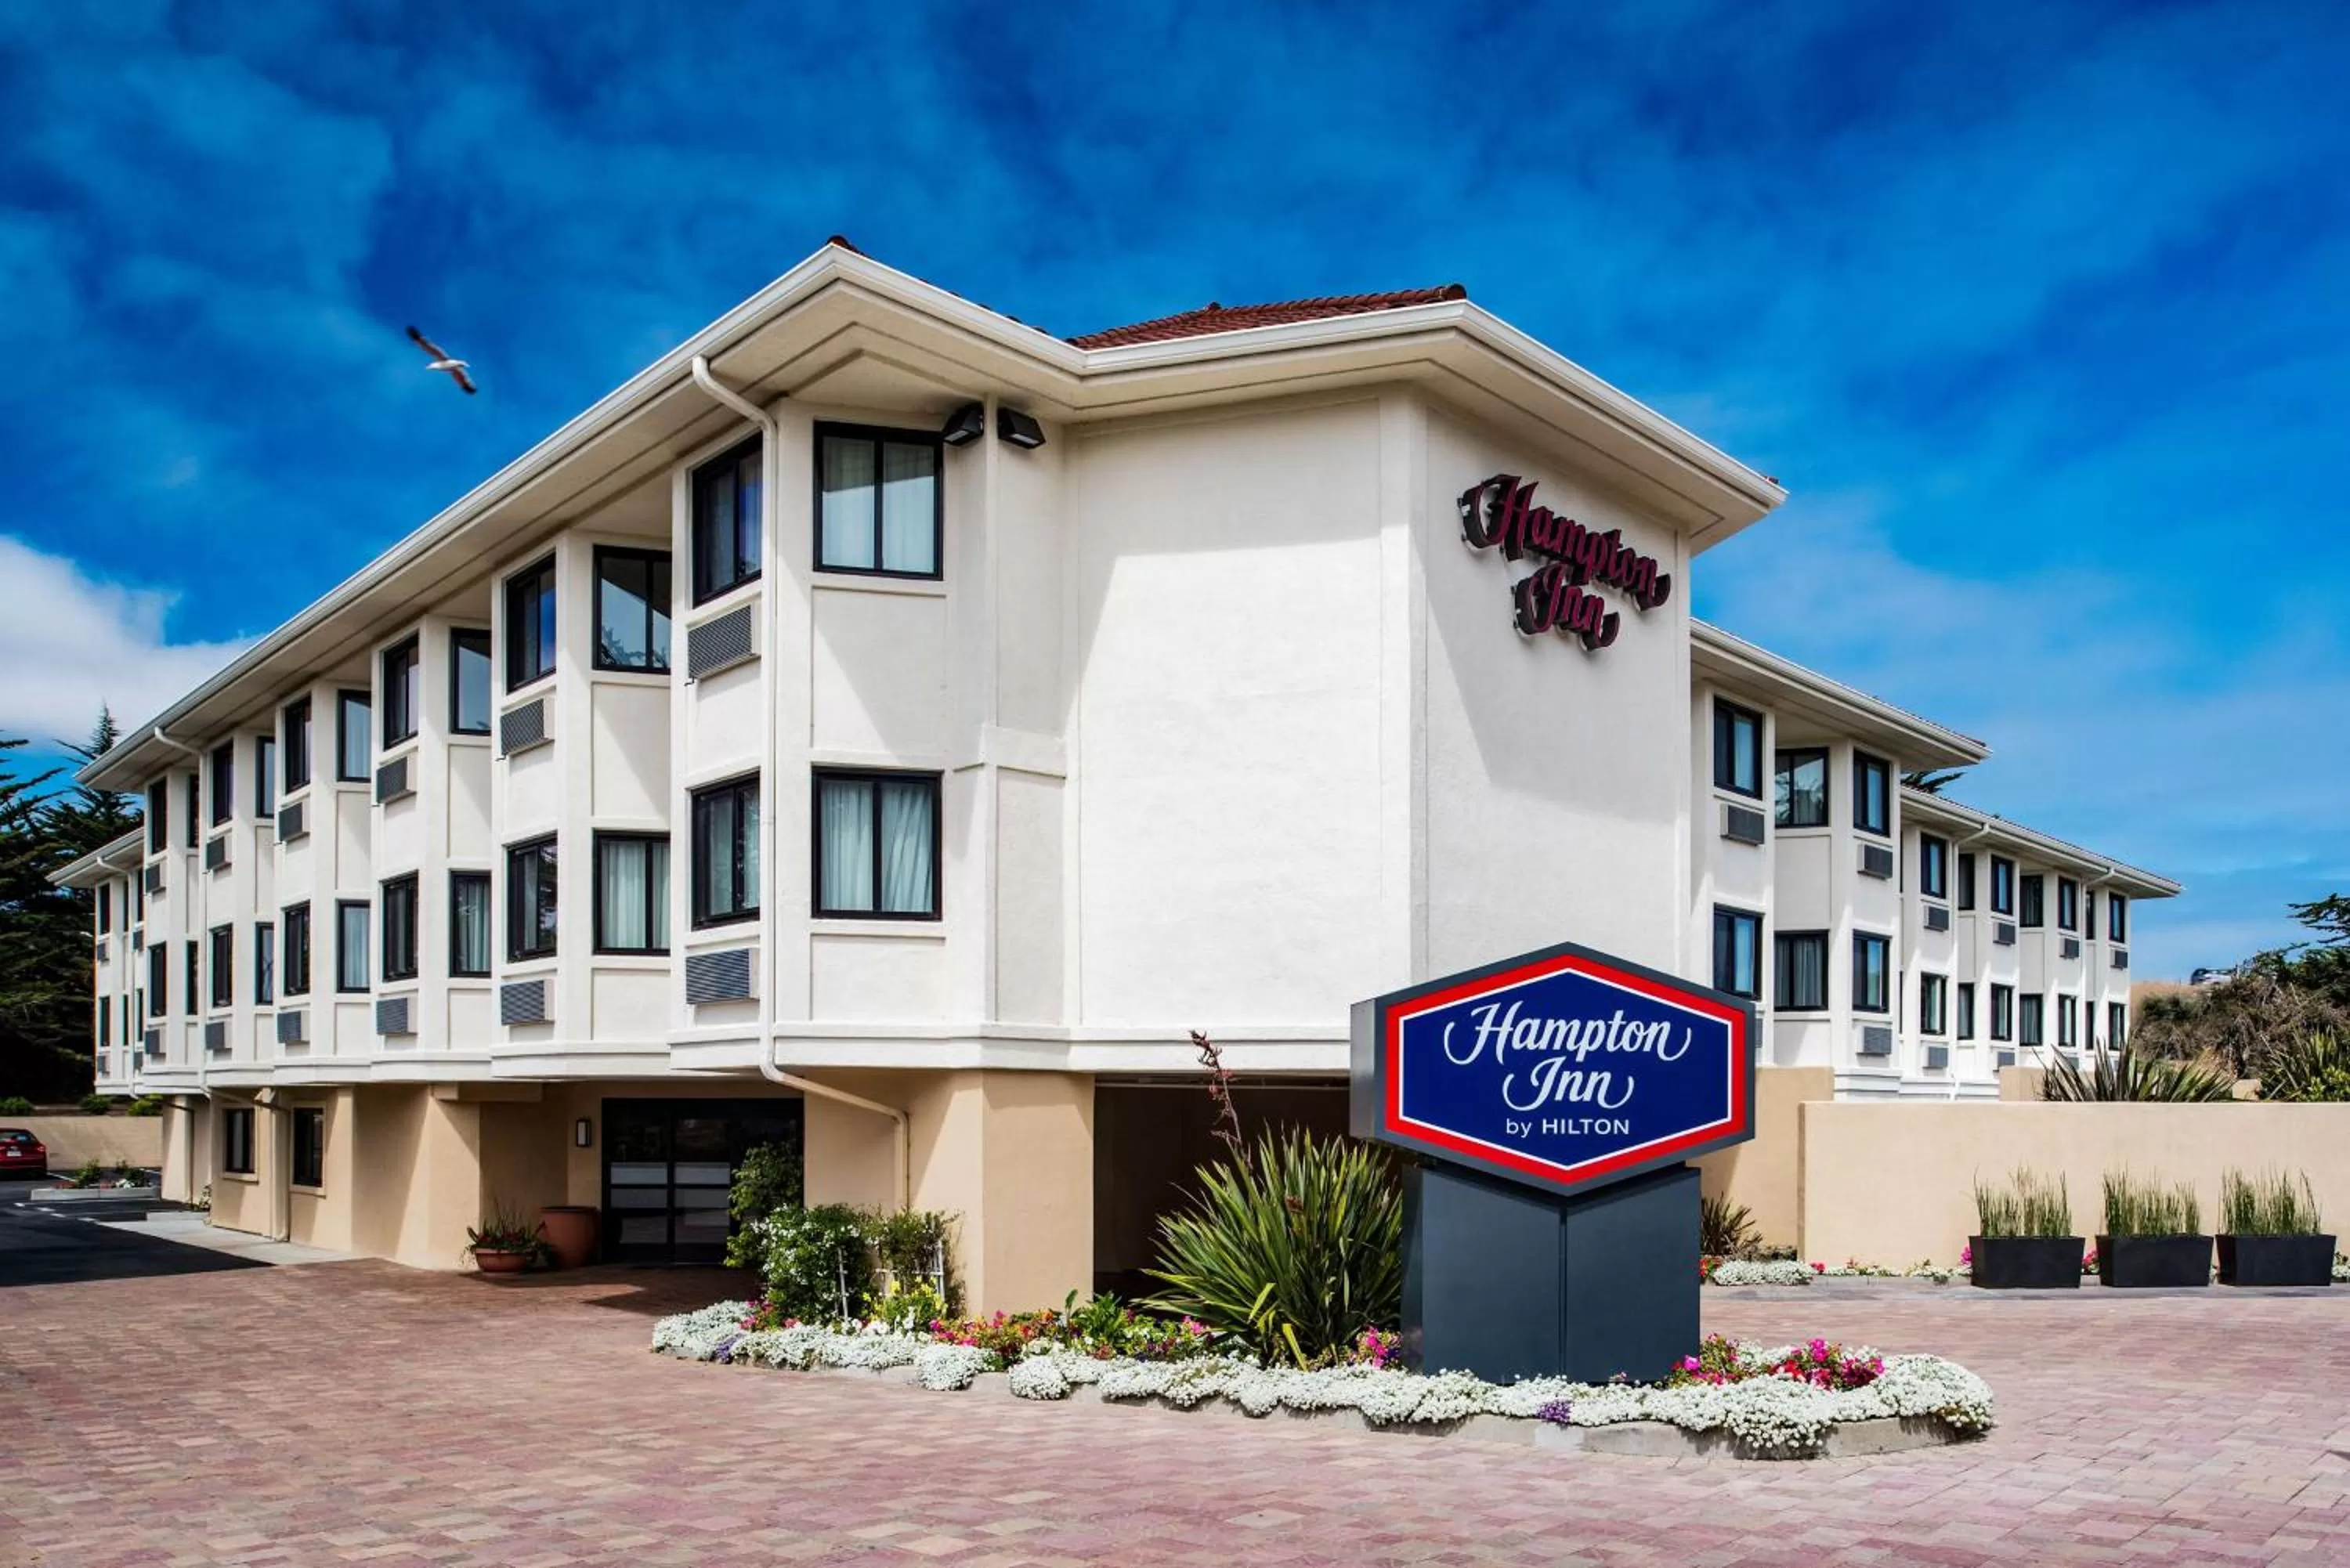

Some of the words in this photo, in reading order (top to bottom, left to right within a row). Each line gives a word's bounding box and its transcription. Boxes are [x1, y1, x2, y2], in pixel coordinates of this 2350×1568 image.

[1459, 474, 1670, 611] Hampton
[1512, 561, 1619, 651] Inn
[1444, 1000, 1692, 1065] Hampton
[1502, 1057, 1635, 1111] Inn
[1506, 1118, 1531, 1138] by
[1542, 1118, 1629, 1135] HILTON
